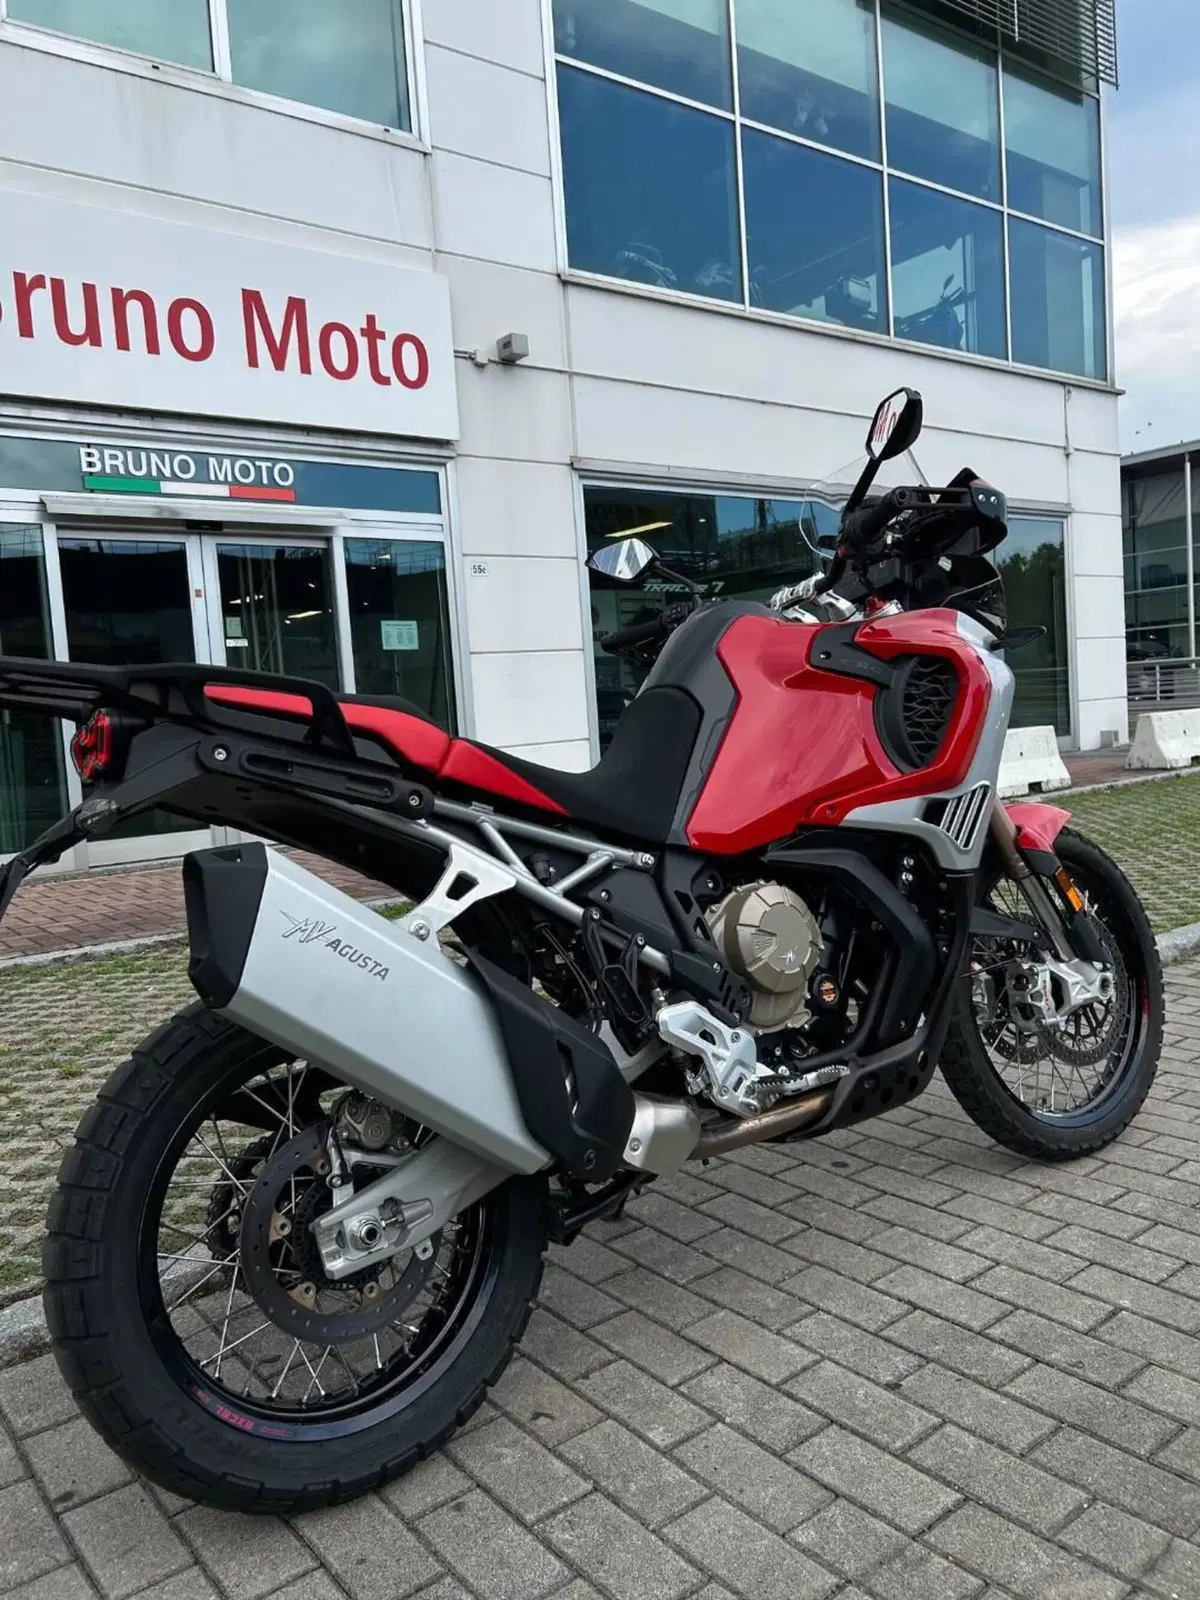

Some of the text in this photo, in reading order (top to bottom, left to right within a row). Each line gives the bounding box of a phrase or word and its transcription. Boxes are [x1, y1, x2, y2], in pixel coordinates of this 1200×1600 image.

[0, 271, 429, 390] runo Moto
[79, 447, 294, 486] BRUNO MOTO
[325, 938, 390, 980] AGUSTA
